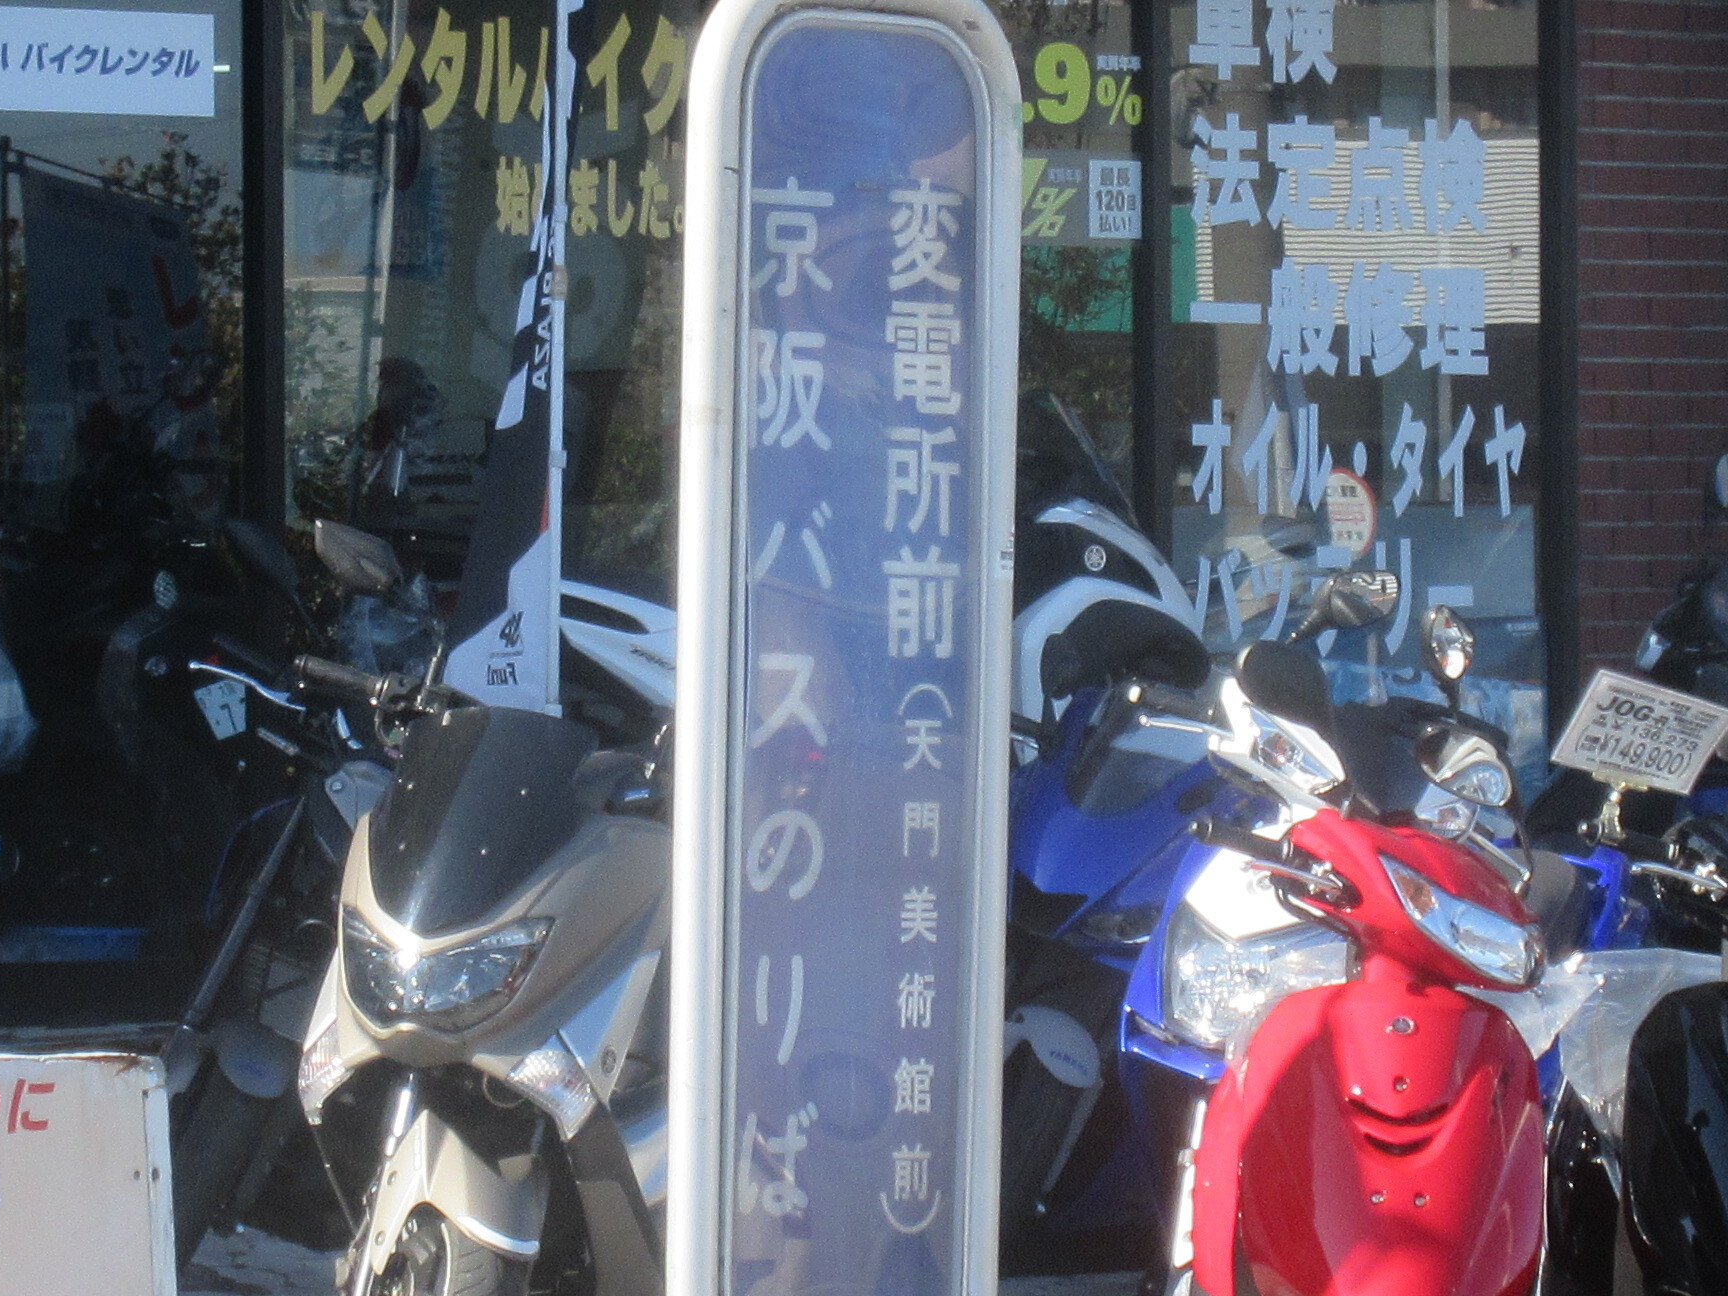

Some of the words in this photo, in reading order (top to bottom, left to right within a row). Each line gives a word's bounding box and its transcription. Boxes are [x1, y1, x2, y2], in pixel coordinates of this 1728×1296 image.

[20, 43, 201, 79] バイクレンタル
[496, 156, 685, 238] 始ました。
[1190, 112, 1489, 234] 法定点検
[1189, 257, 1490, 377] 一般修理
[881, 177, 964, 660] 変電所前
[1191, 399, 1527, 519] オイル・タイヤ
[736, 177, 835, 1220] 京阪バスのりば
[1595, 695, 1655, 723] JOG
